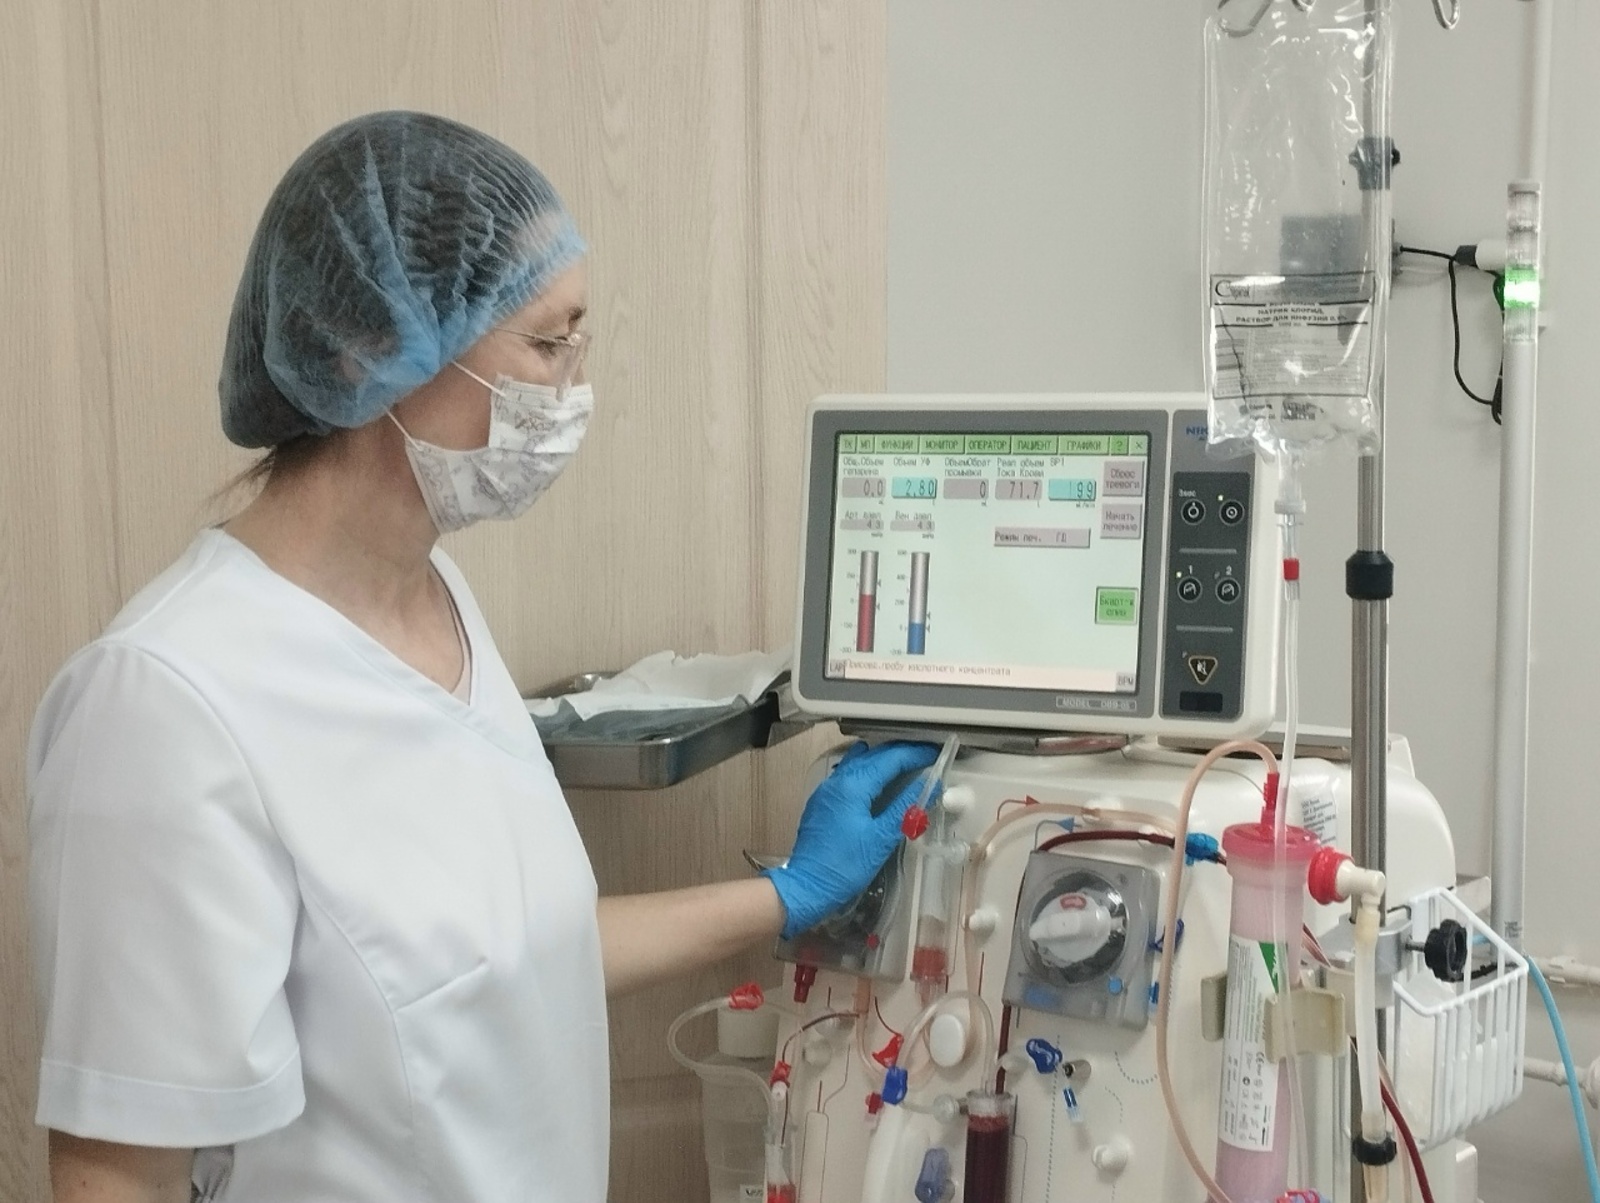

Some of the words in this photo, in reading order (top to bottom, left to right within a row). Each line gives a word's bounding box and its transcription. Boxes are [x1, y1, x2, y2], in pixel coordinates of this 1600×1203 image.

[880, 440, 914, 450] ФУНКЦИИ
[925, 440, 959, 450] МОНИТОР
[968, 440, 1007, 450] ОПЕРАТОР
[1017, 441, 1052, 450] ПАЦИЕНТ
[1066, 441, 1101, 450] ГРАФИКИ
[1110, 468, 1136, 479] Сброс
[979, 480, 987, 498] 0
[1009, 480, 1039, 499] 71.7
[1225, 565, 1232, 576] 2
